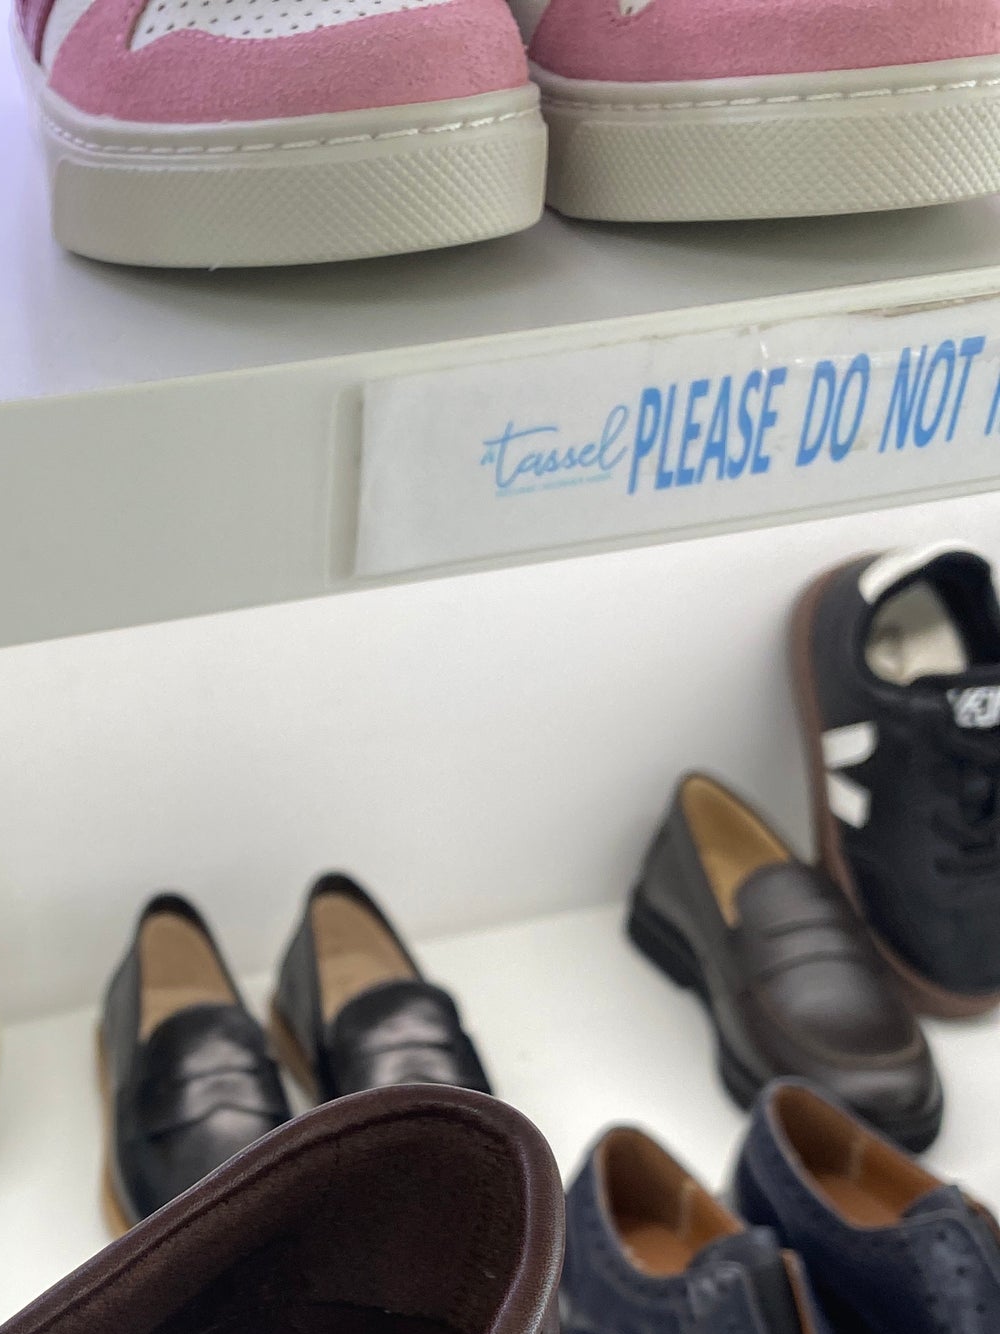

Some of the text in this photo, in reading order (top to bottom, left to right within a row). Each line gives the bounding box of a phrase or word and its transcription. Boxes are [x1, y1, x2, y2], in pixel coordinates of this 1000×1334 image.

[627, 366, 788, 495] PLEASE
[795, 353, 870, 467] DO
[878, 335, 986, 454] NOT
